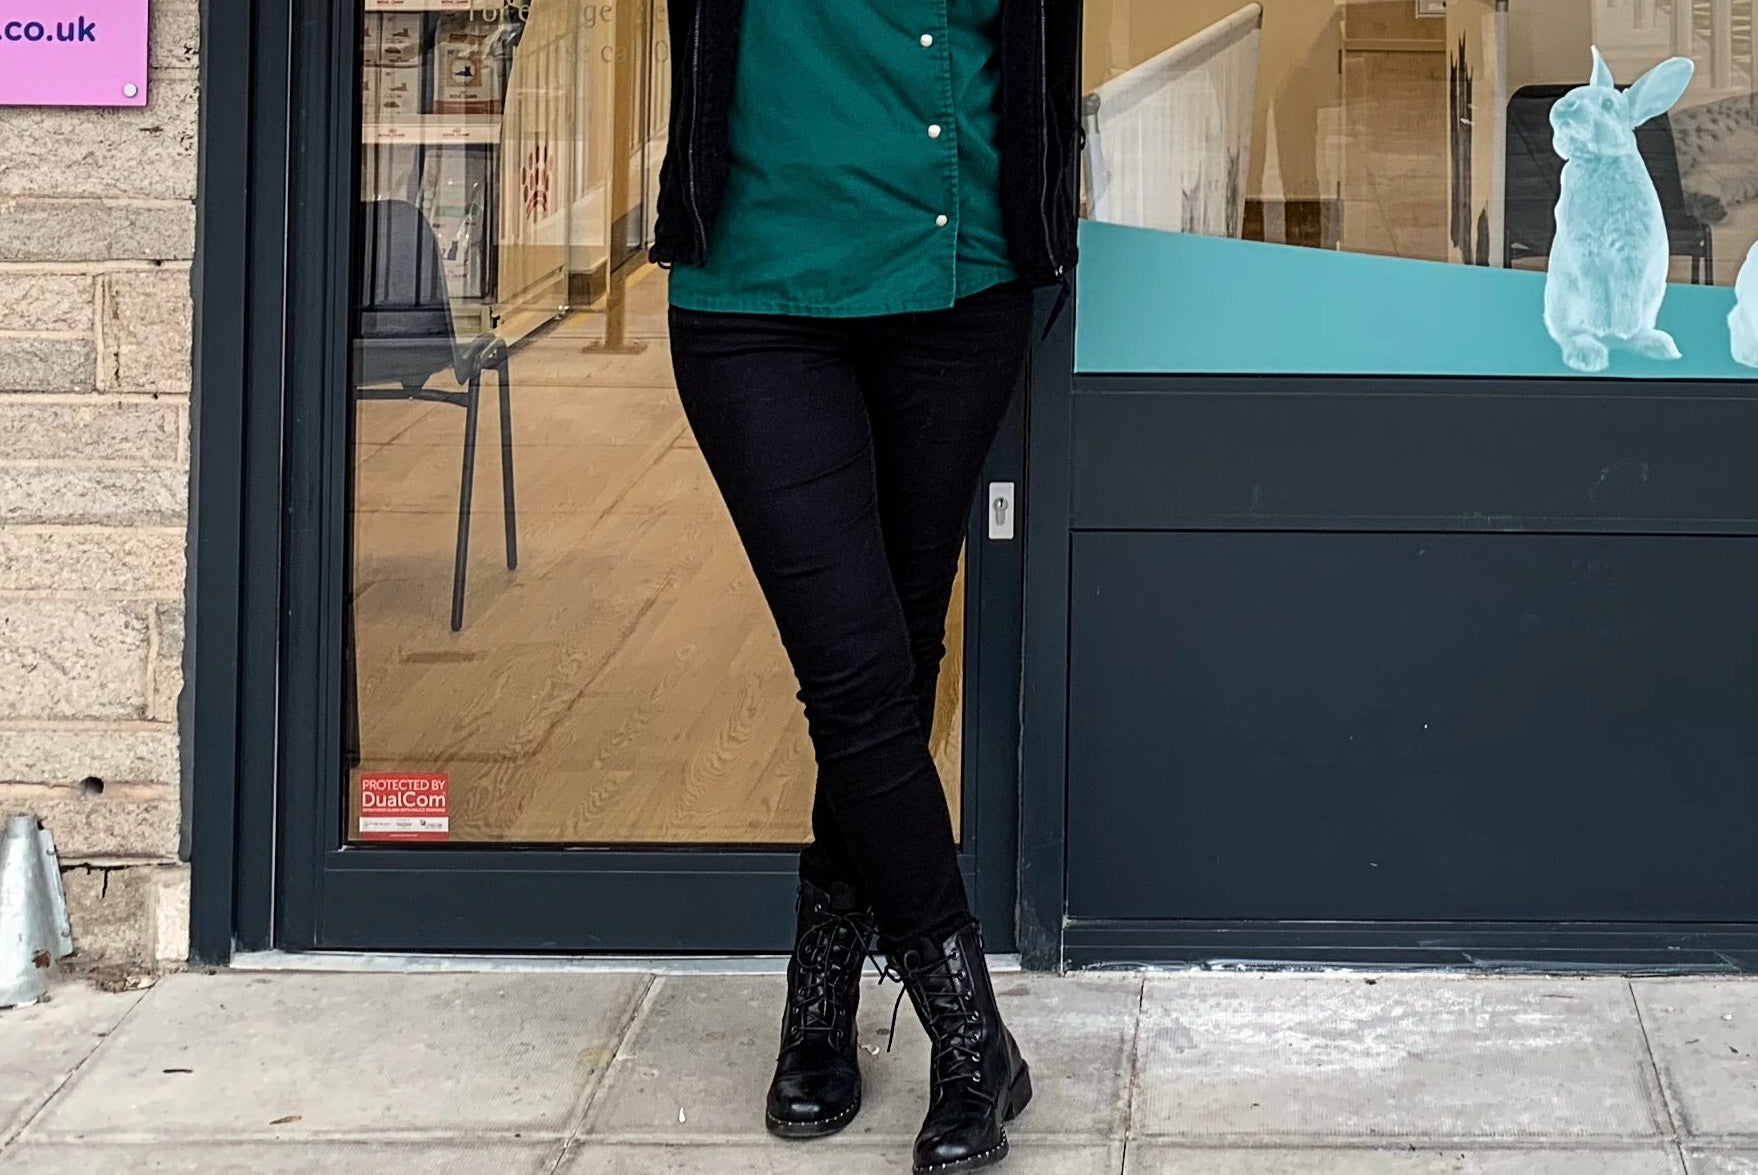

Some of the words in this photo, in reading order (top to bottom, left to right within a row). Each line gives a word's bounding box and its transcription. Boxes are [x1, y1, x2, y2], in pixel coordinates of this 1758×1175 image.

[362, 779, 430, 791] PROTECTED
[431, 779, 446, 791] BY
[362, 791, 447, 808] DualCom
